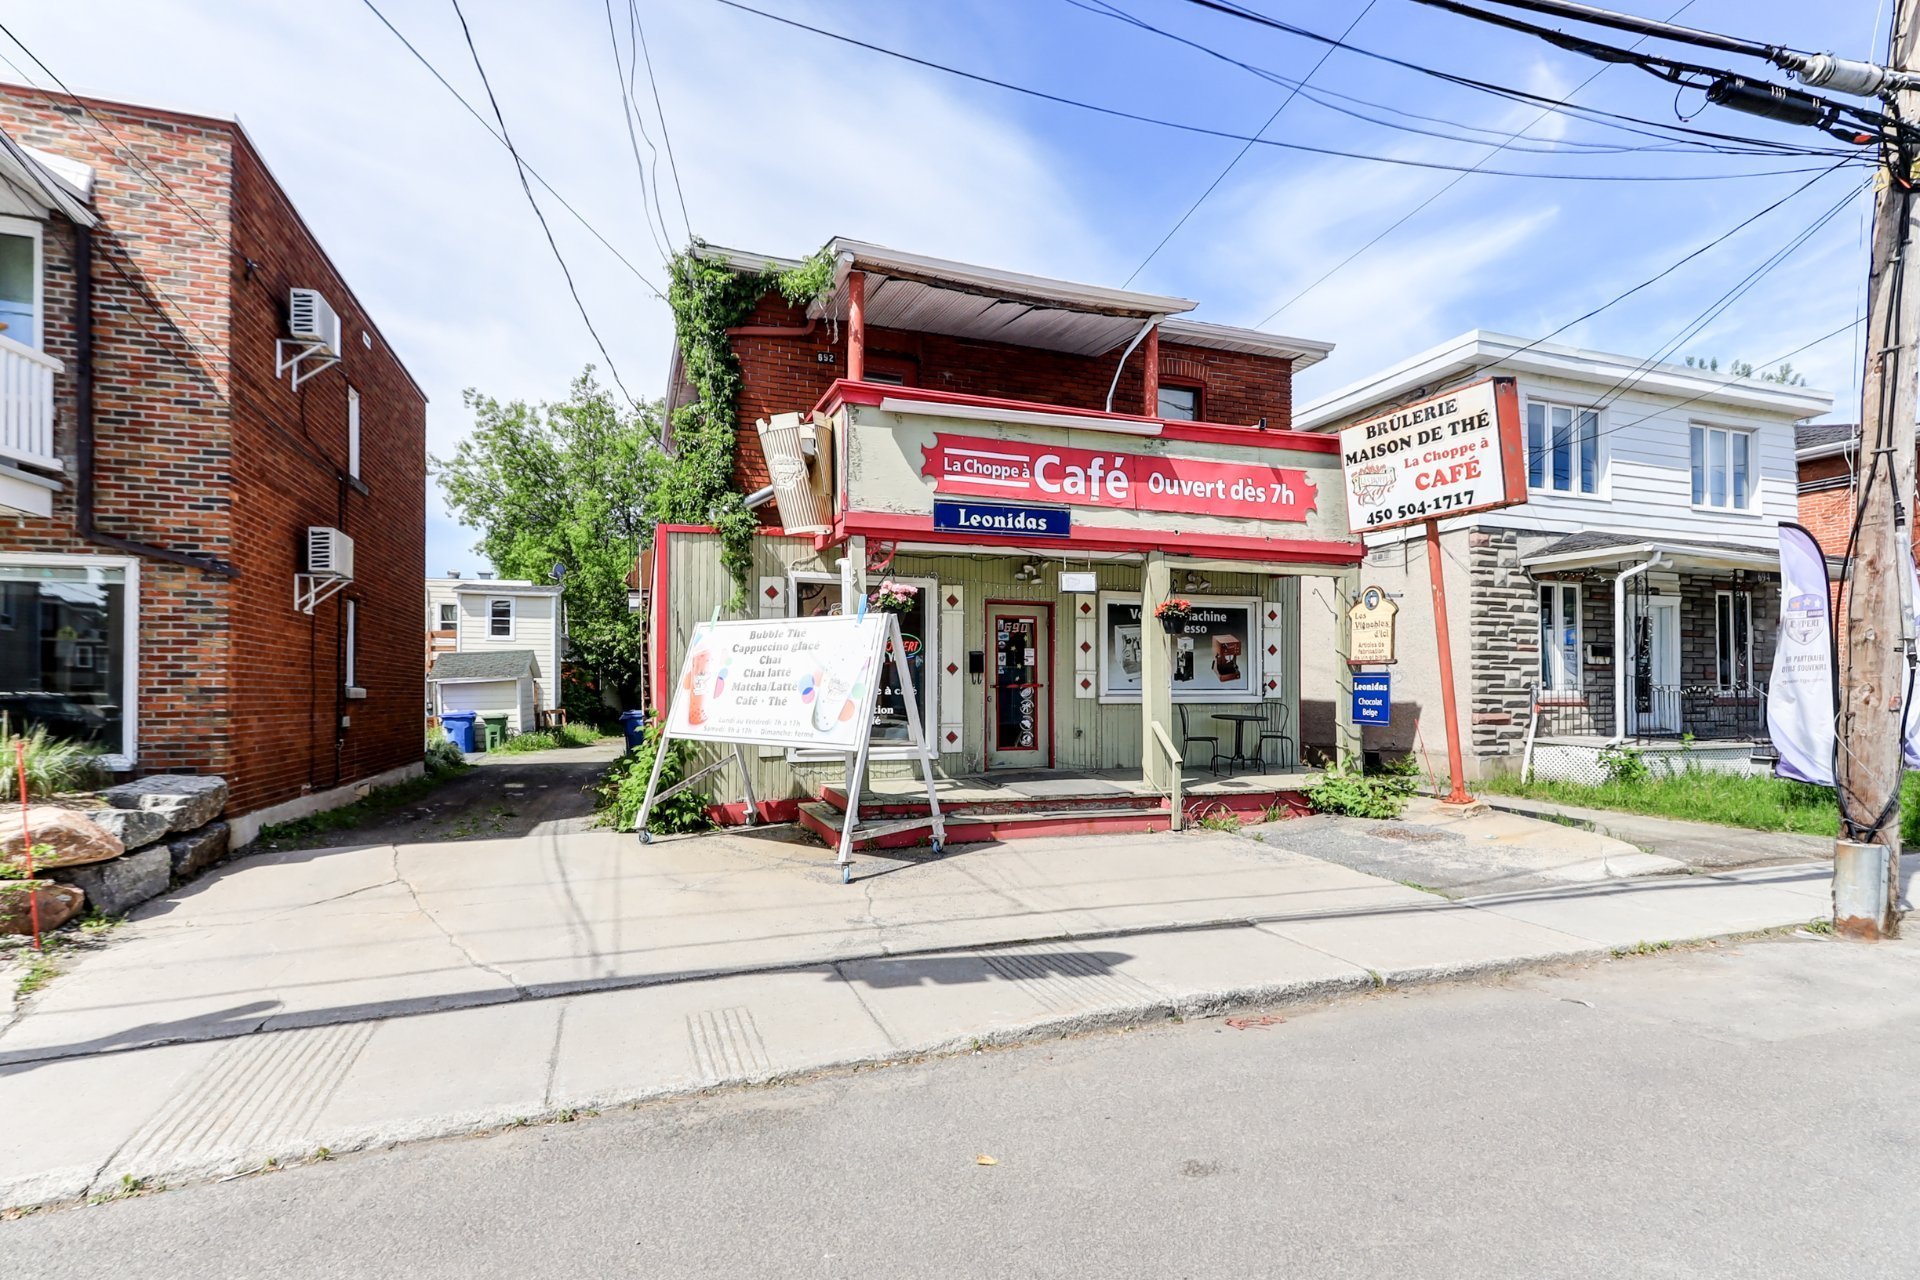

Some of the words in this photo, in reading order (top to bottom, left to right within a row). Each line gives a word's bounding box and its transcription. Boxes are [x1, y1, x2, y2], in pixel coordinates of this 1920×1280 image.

[818, 353, 834, 362] 692
[1366, 398, 1458, 440] BRÛLERIE
[1345, 435, 1412, 467] MAISON
[1418, 426, 1443, 446] DE
[1448, 409, 1490, 437] THÉ
[1404, 457, 1420, 470] La
[1423, 443, 1476, 464] Choppe
[1480, 437, 1489, 449] à
[944, 457, 961, 472] La
[963, 459, 1019, 479] Choppe
[1022, 463, 1030, 479] à
[1415, 456, 1482, 491] CAFÉ
[1034, 454, 1129, 501] Café
[1149, 472, 1226, 499] Ouvert
[1230, 478, 1266, 503] dès
[1270, 484, 1295, 505] 7h
[1366, 508, 1392, 526] 450
[1397, 490, 1474, 519] 504-1717
[958, 508, 1047, 531] Leonidas
[1188, 611, 1227, 622] achine
[1354, 612, 1367, 620] Les
[1004, 622, 1028, 633] 690
[749, 629, 784, 640] Bubble
[732, 642, 789, 655] Cappuccino
[759, 654, 782, 665] Chai
[743, 668, 765, 678] Chai
[884, 686, 892, 695] à
[894, 686, 917, 695] caé
[1354, 682, 1388, 691] Leonidas
[735, 695, 758, 706] Café
[768, 694, 788, 706] Thé
[1358, 697, 1383, 706] Chocolat
[1362, 708, 1378, 717] Belge
